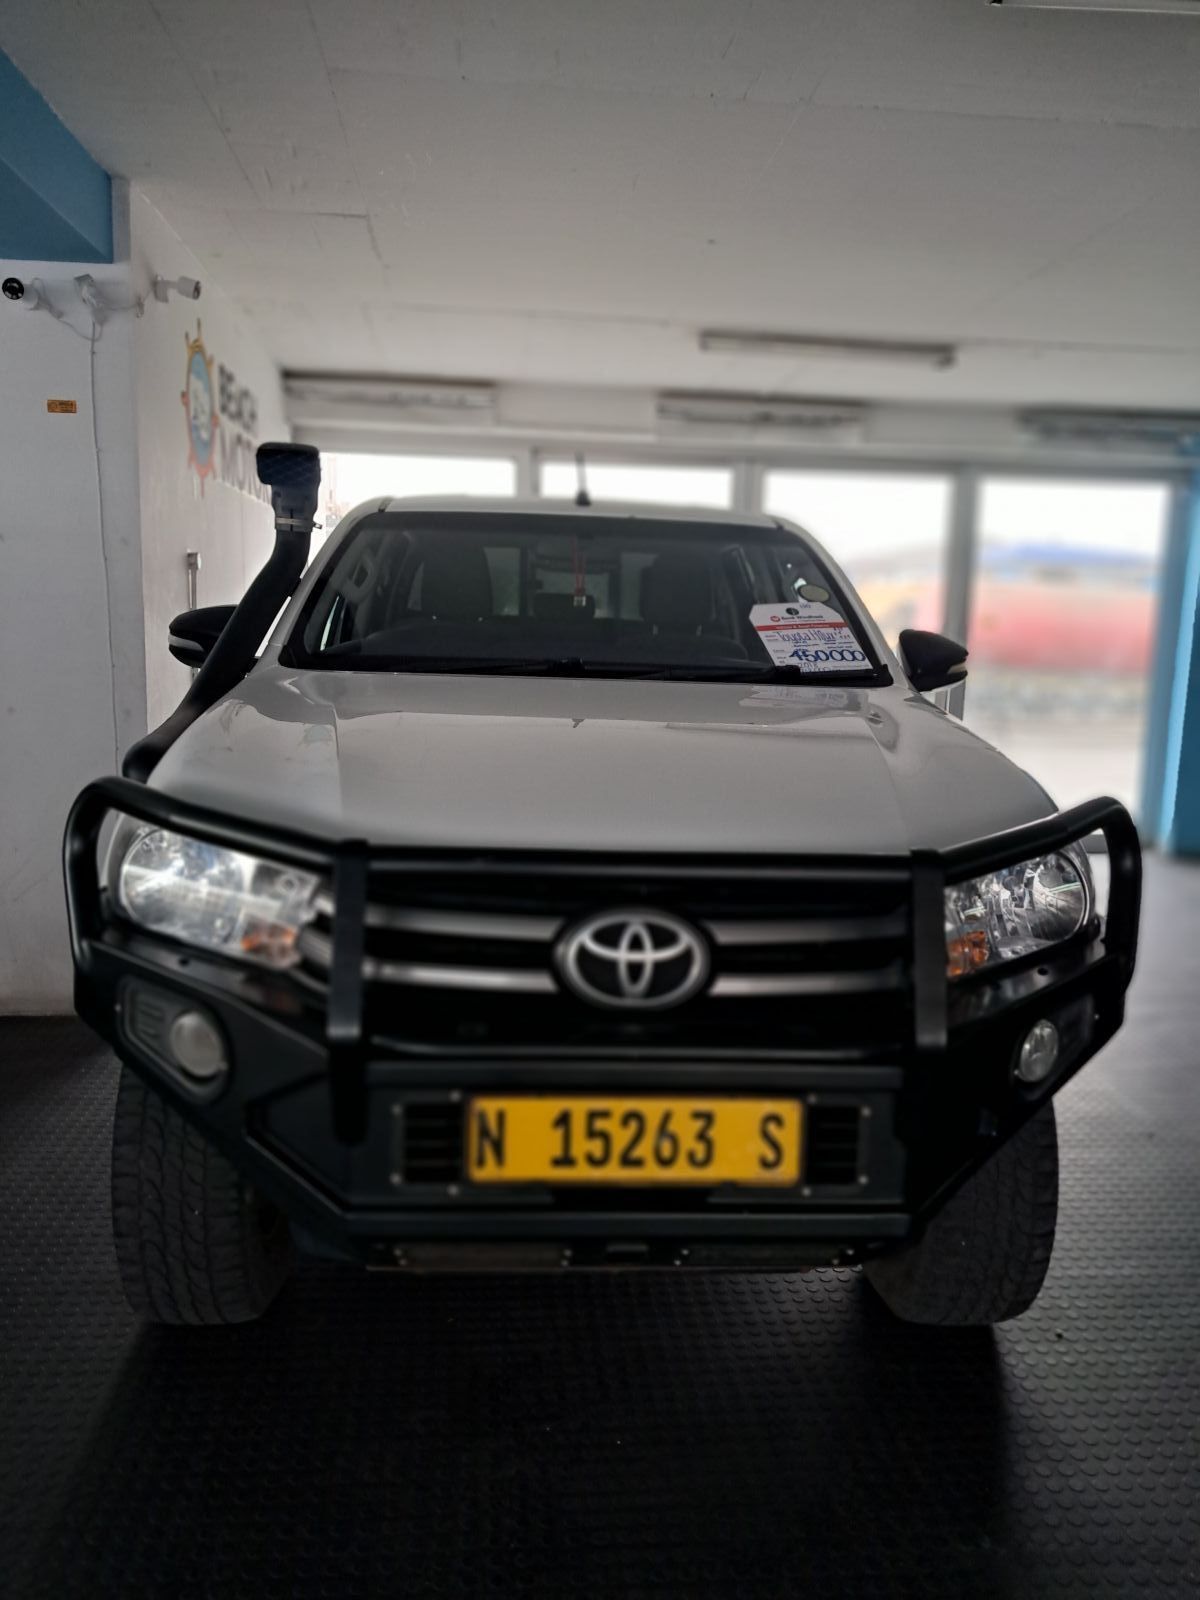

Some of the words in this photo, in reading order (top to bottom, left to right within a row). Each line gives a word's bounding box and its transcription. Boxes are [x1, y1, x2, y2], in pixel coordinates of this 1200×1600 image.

[776, 630, 811, 642] Toyota
[475, 1108, 506, 1168] N
[550, 1108, 715, 1169] 15263
[758, 1113, 786, 1171] S
